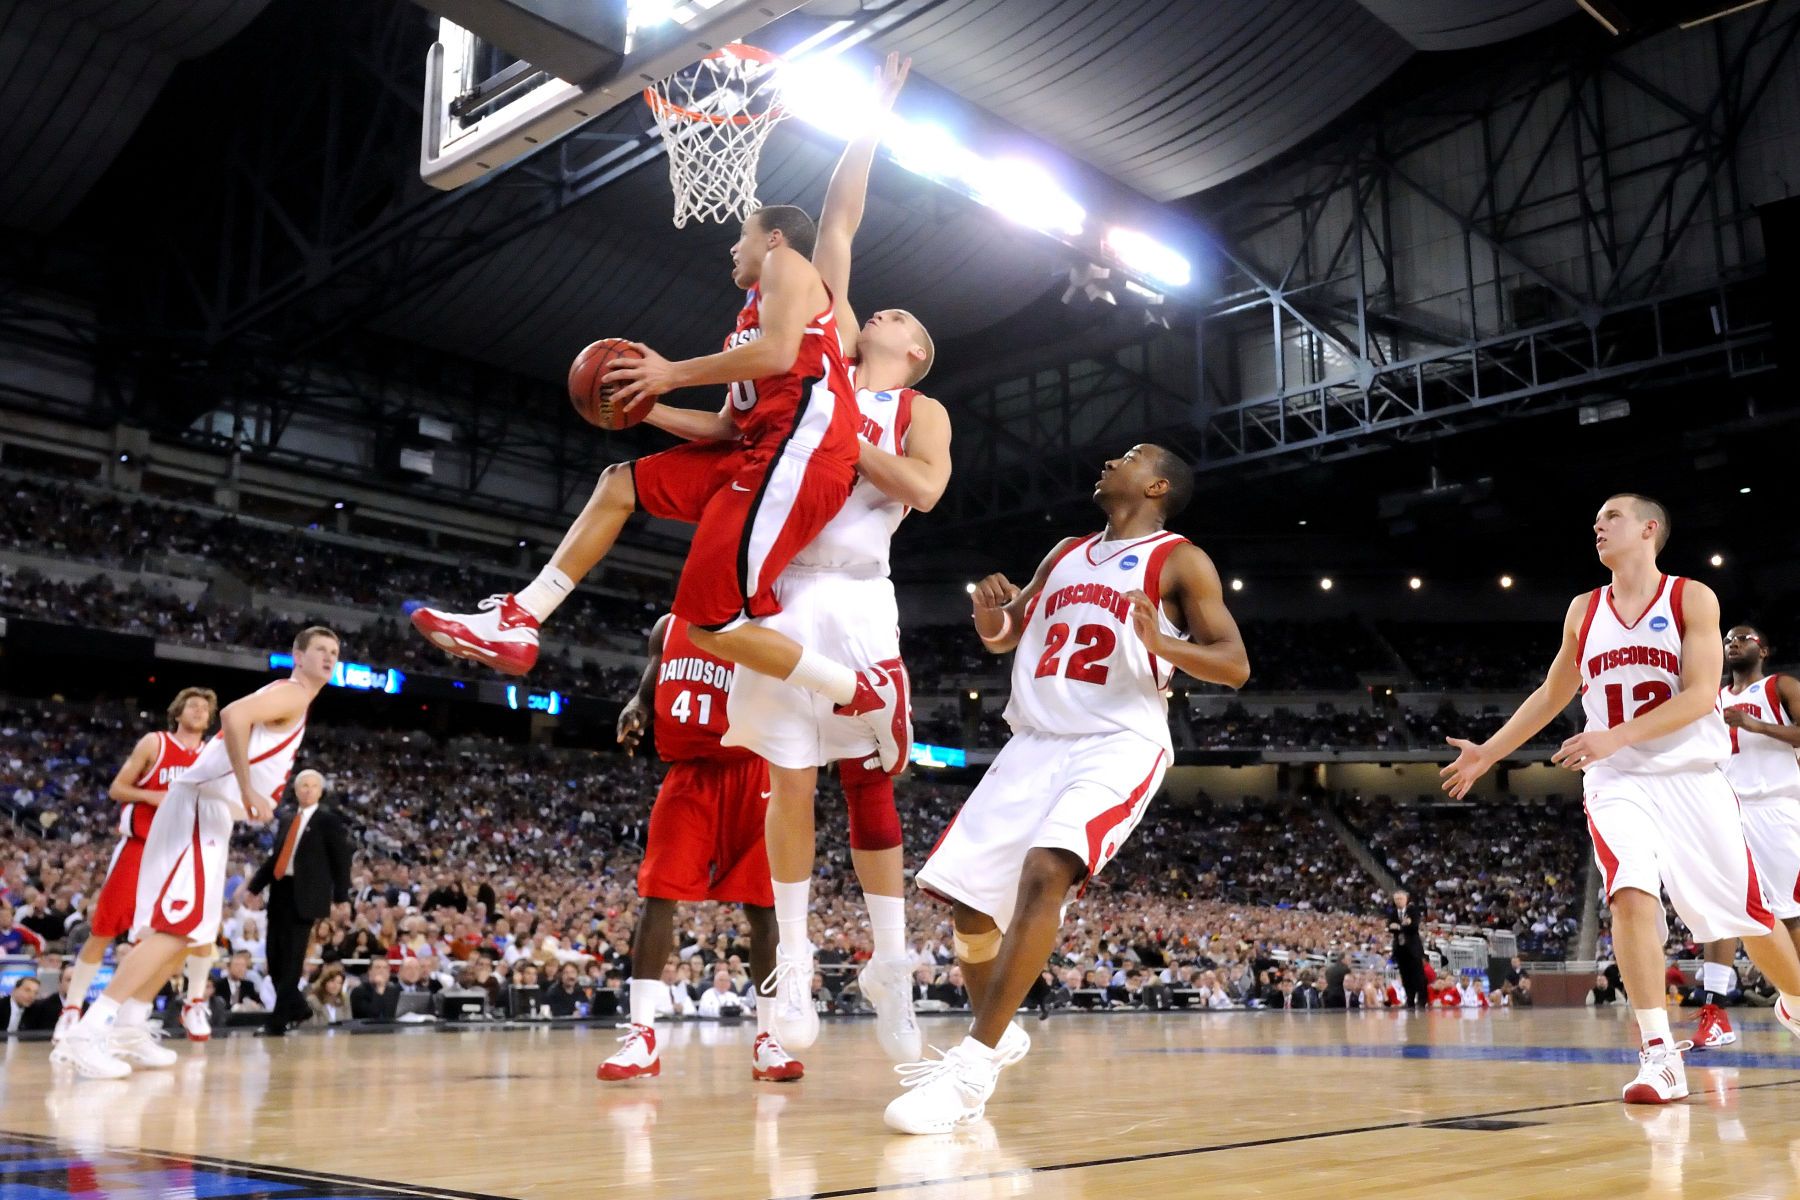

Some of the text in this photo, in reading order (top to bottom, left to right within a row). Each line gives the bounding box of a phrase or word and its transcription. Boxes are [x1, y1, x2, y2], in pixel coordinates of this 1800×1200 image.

[1044, 582, 1131, 625] WISCONSIN
[1034, 622, 1117, 685] 22
[1587, 645, 1680, 679] WISCONSIN
[670, 689, 712, 725] 41
[1604, 680, 1672, 730] 12
